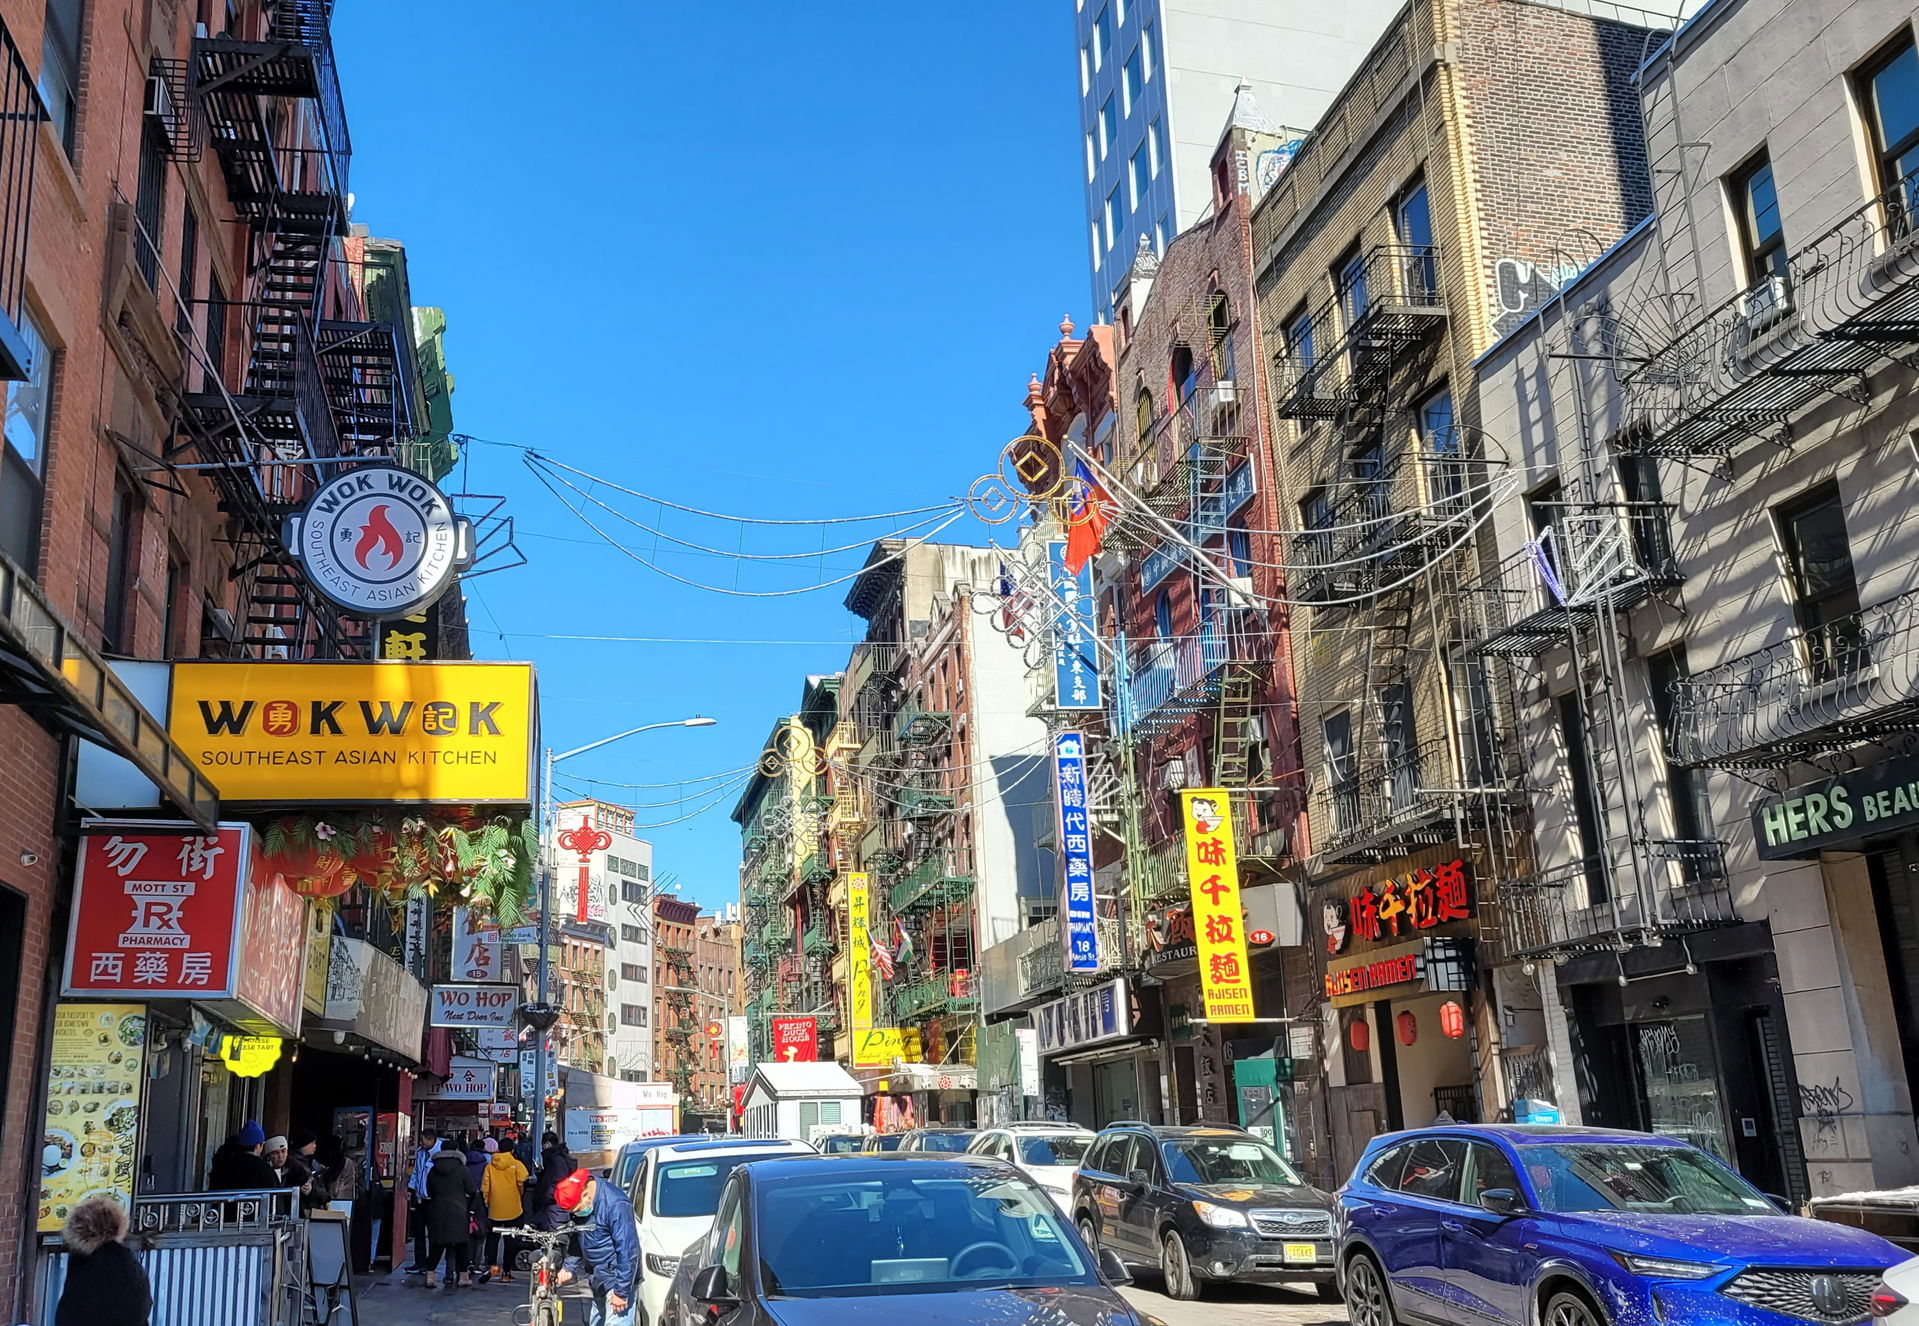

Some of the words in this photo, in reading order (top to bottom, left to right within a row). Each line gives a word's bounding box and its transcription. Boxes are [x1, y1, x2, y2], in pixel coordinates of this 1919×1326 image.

[315, 473, 375, 515] WOK
[387, 473, 442, 518] WOK
[405, 531, 422, 544] 記
[310, 519, 360, 597] SOUTHEAST
[366, 582, 416, 601] ASIAN
[417, 521, 448, 585] KITCHEN
[201, 750, 327, 766] SOUTHEAST
[334, 750, 397, 766] ASIAN
[408, 750, 497, 766] KITCHEN
[1762, 785, 1854, 847] HERS
[131, 883, 166, 893] MOTT
[172, 884, 187, 893] ST
[1350, 859, 1471, 942] 味千拉麵
[1196, 837, 1242, 985] 味千拉麵
[121, 936, 186, 946] PHARMACY
[1254, 933, 1268, 942] 16
[1076, 940, 1090, 953] 18
[90, 951, 212, 985] 西藥房
[1369, 953, 1417, 989] RAMEN
[438, 990, 470, 1007] WO
[475, 991, 513, 1008] HOP
[1207, 987, 1248, 1000] AJISEN
[444, 1009, 465, 1021] Next
[467, 1010, 488, 1021] Door
[490, 1011, 504, 1021] Inc
[1209, 1004, 1250, 1016] RAMEN
[782, 1028, 808, 1037] DUCK
[862, 1030, 913, 1051] Ping
[443, 1083, 462, 1093] WO
[465, 1083, 487, 1093] HOP
